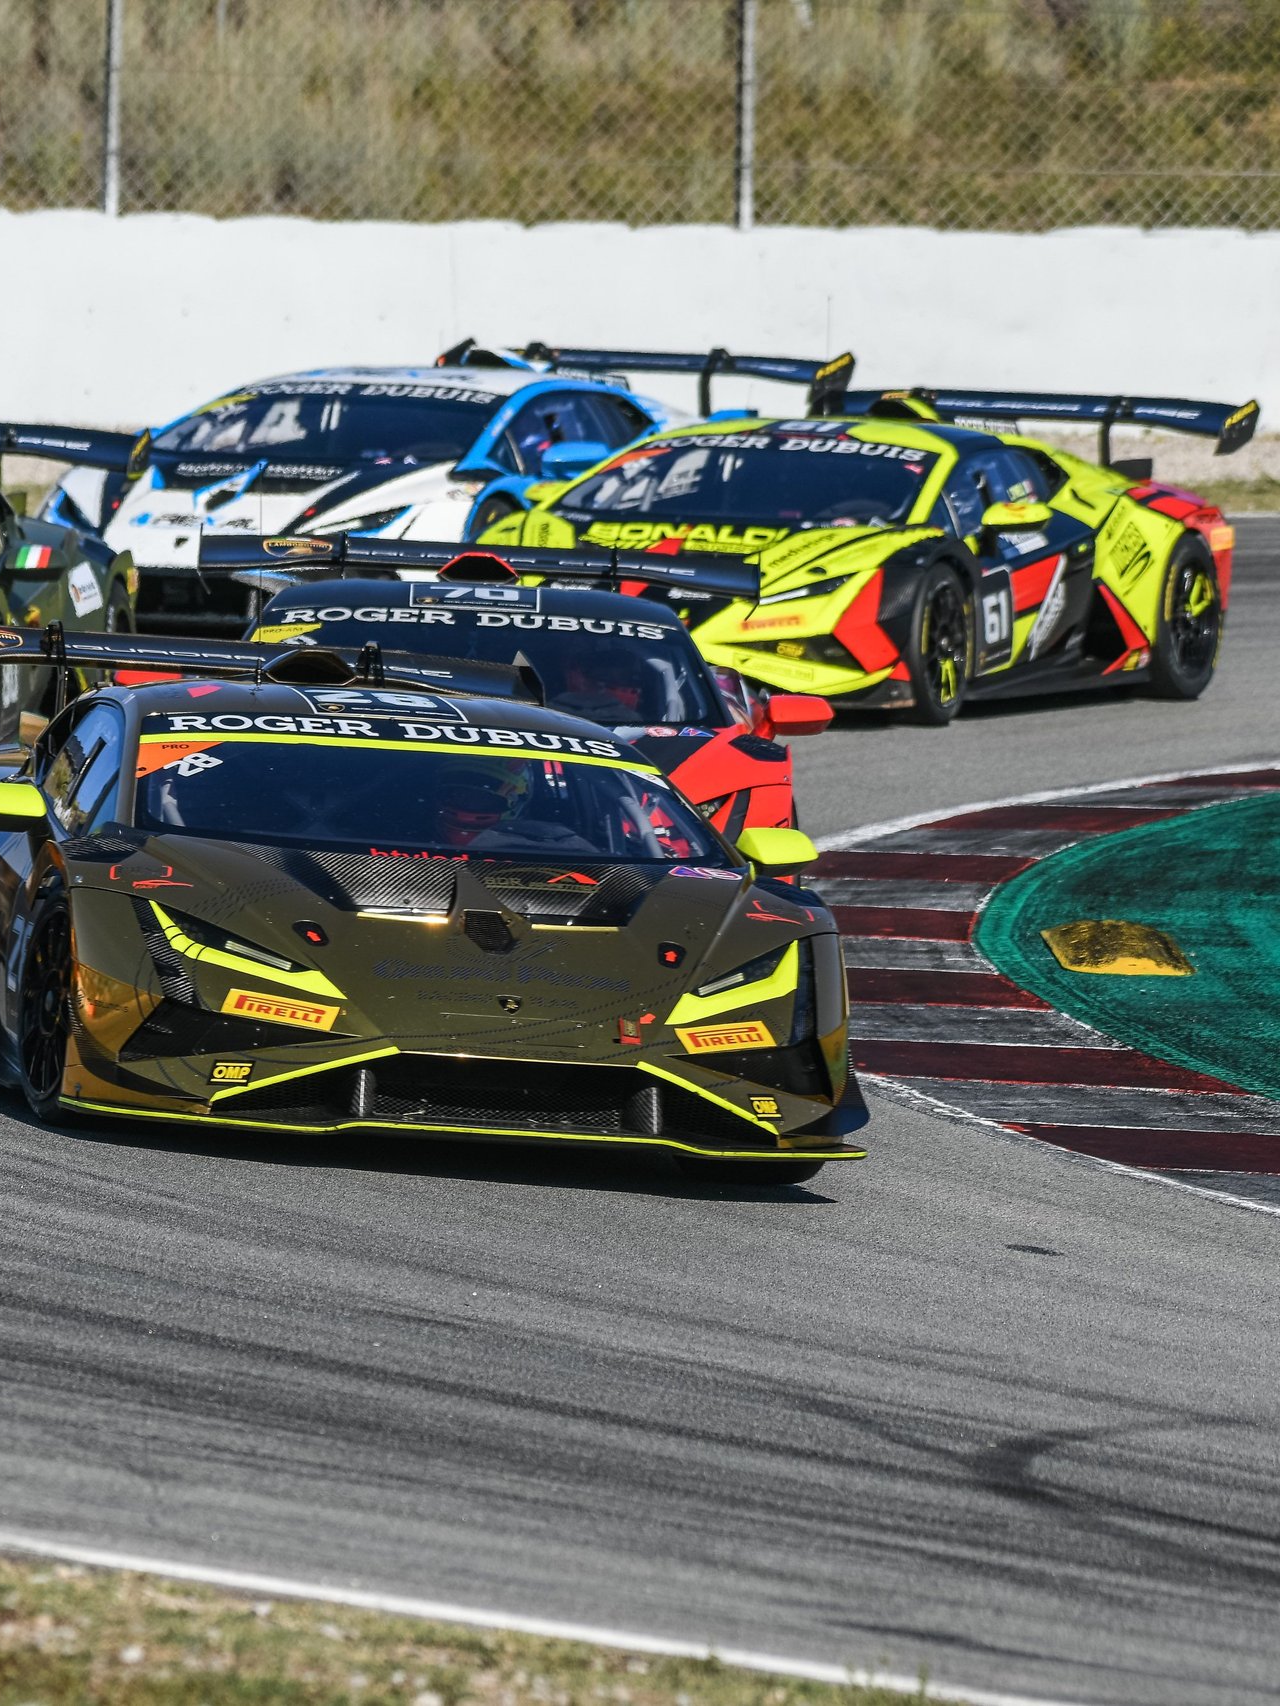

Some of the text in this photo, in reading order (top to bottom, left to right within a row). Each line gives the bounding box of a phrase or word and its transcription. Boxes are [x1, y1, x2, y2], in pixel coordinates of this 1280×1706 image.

[780, 437, 929, 461] DUBUIS
[429, 586, 520, 601] 70
[280, 606, 667, 640] ROGER DUBUIS
[982, 588, 1010, 645] 61
[168, 715, 622, 758] ROGER DUBUIS
[163, 752, 223, 778] 28
[234, 995, 327, 1024] PIRELLI
[685, 1026, 764, 1048] PIRELLI
[212, 1064, 251, 1081] OMP
[751, 1098, 780, 1116] OMP
